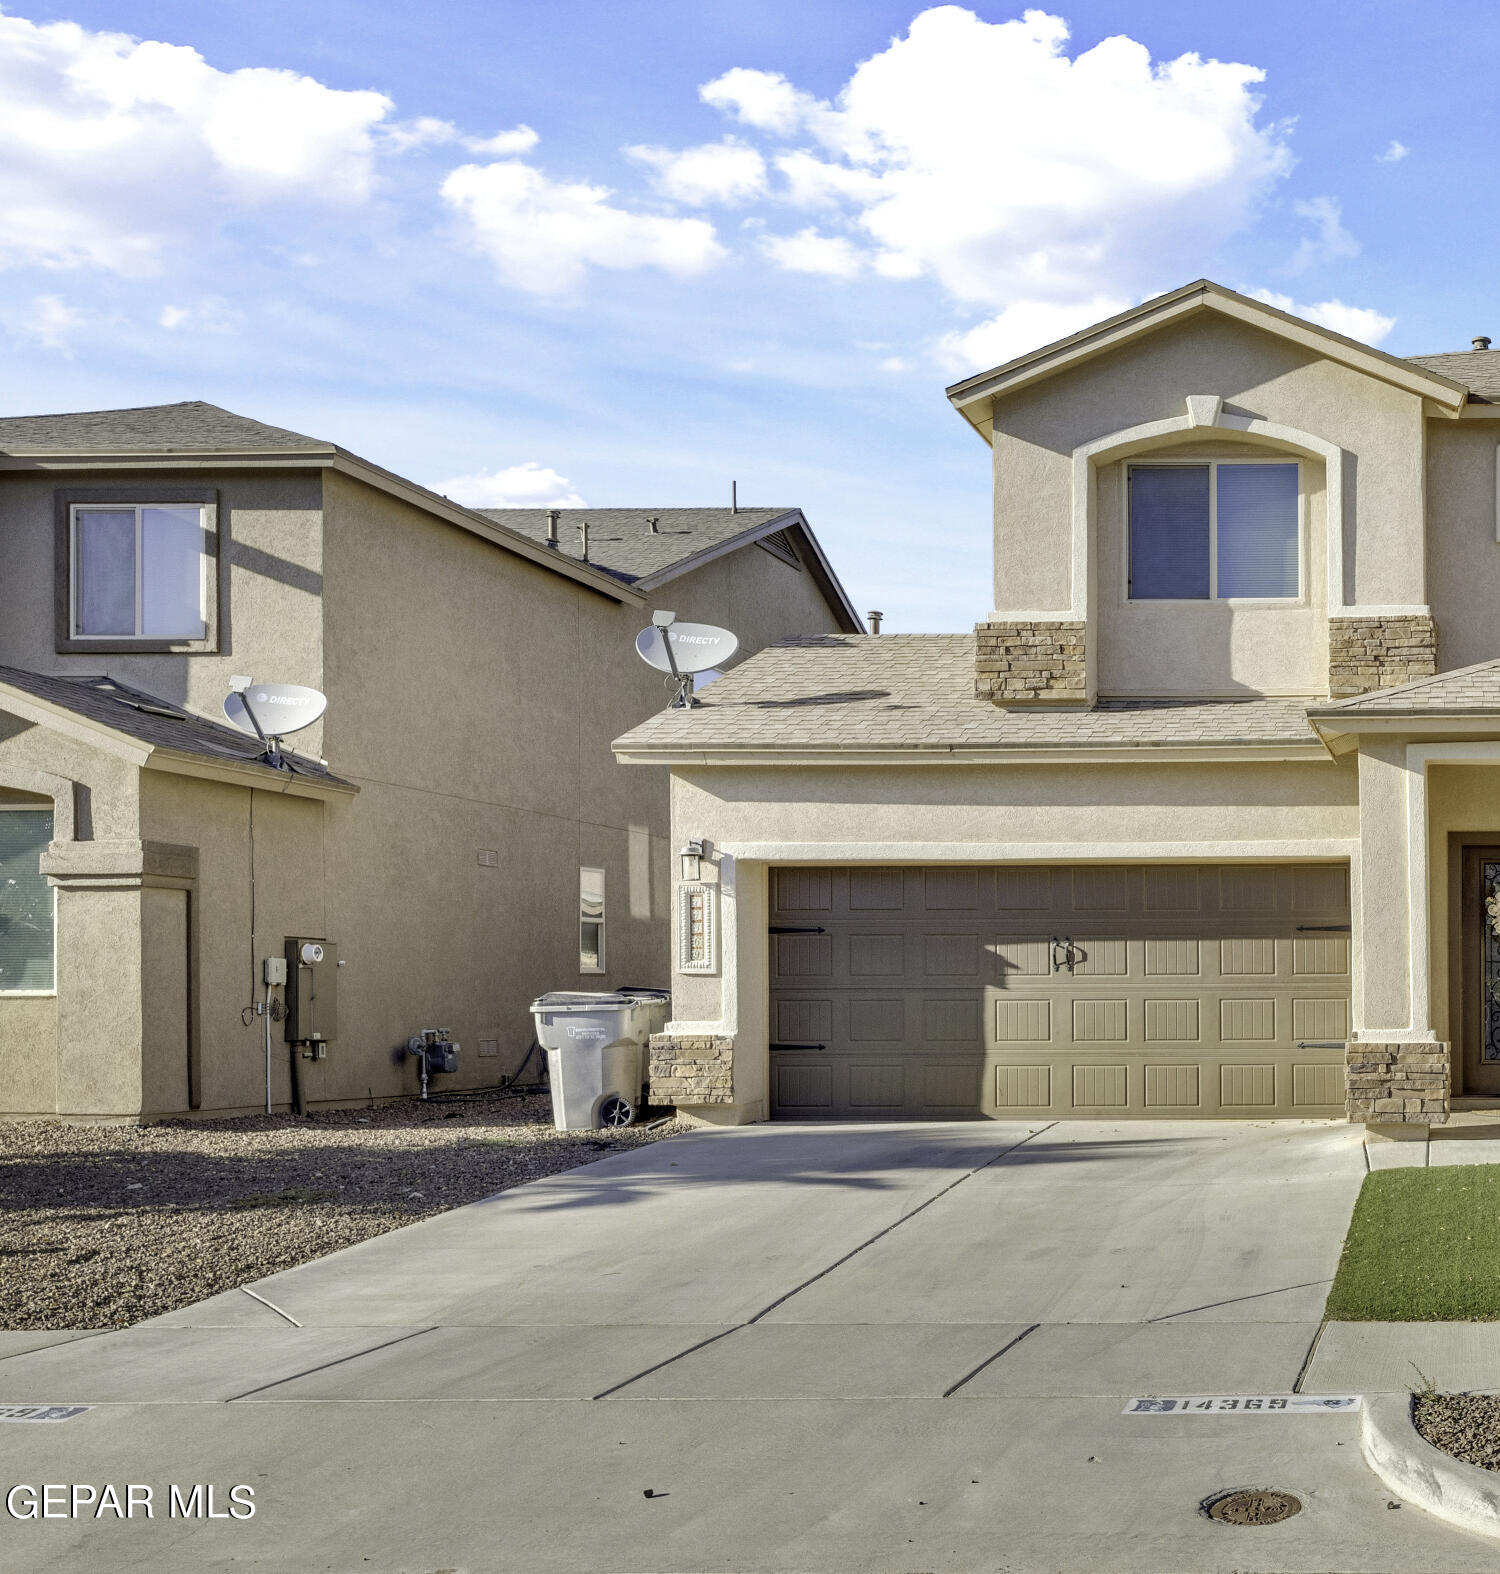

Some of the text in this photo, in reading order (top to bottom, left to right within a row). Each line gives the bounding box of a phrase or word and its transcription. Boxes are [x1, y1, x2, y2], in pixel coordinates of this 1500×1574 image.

[679, 634, 721, 645] DIRECTV
[269, 695, 311, 705] DIRECTV
[1180, 1398, 1289, 1410] 14369
